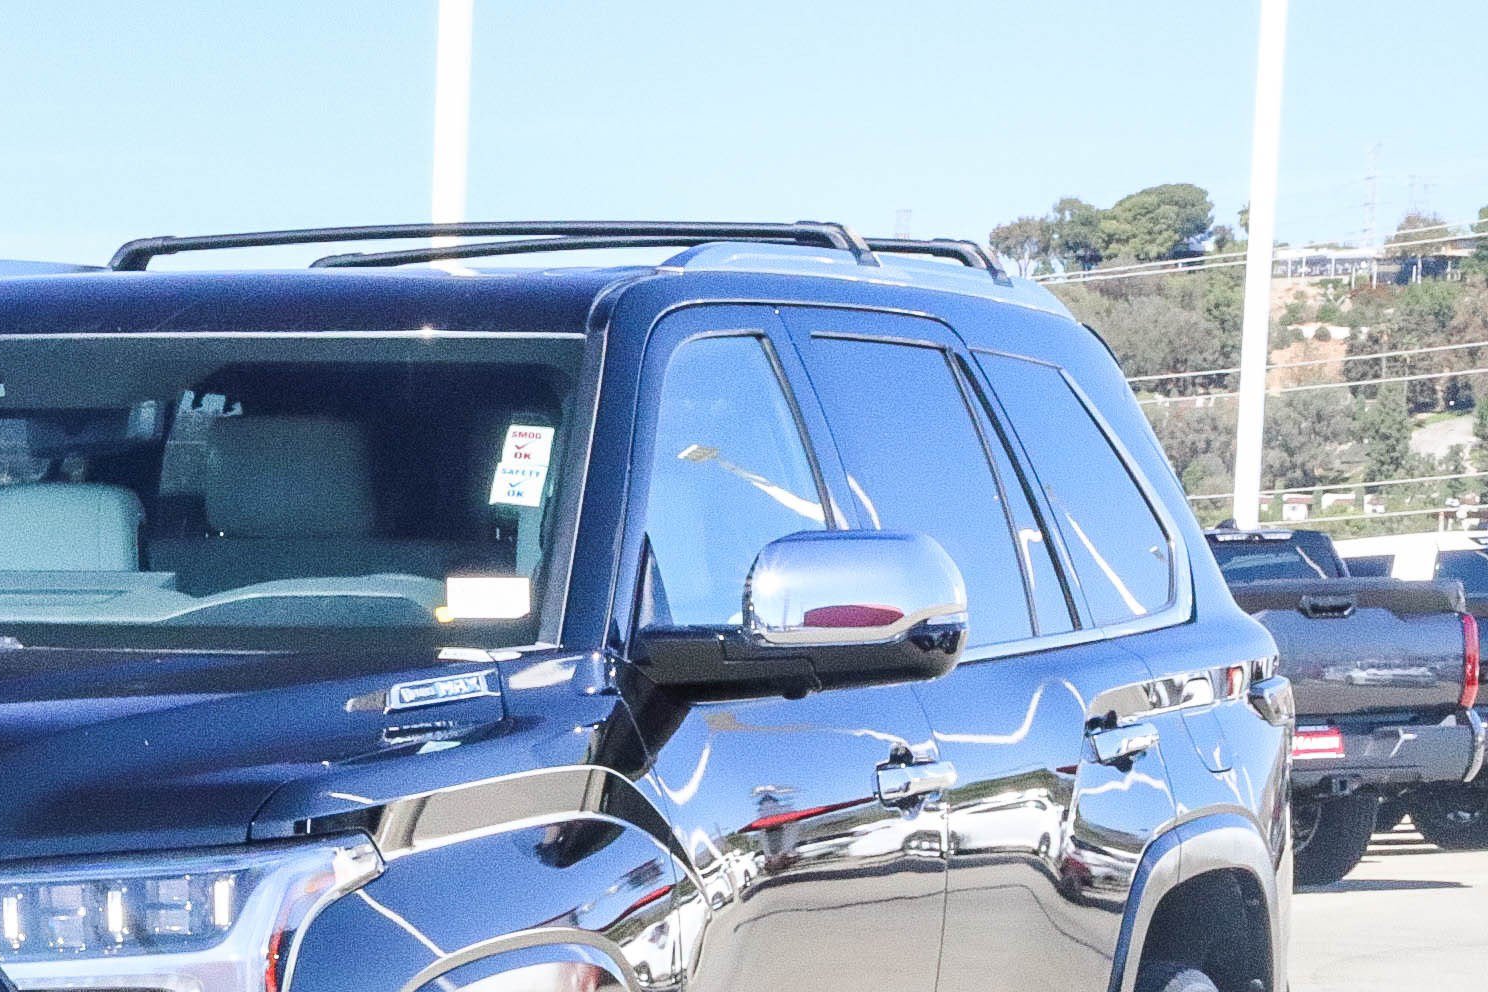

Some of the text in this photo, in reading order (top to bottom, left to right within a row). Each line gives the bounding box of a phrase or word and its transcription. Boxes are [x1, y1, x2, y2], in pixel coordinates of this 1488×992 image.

[511, 430, 543, 441] SMOG
[513, 451, 532, 461] OK
[506, 489, 524, 499] OK
